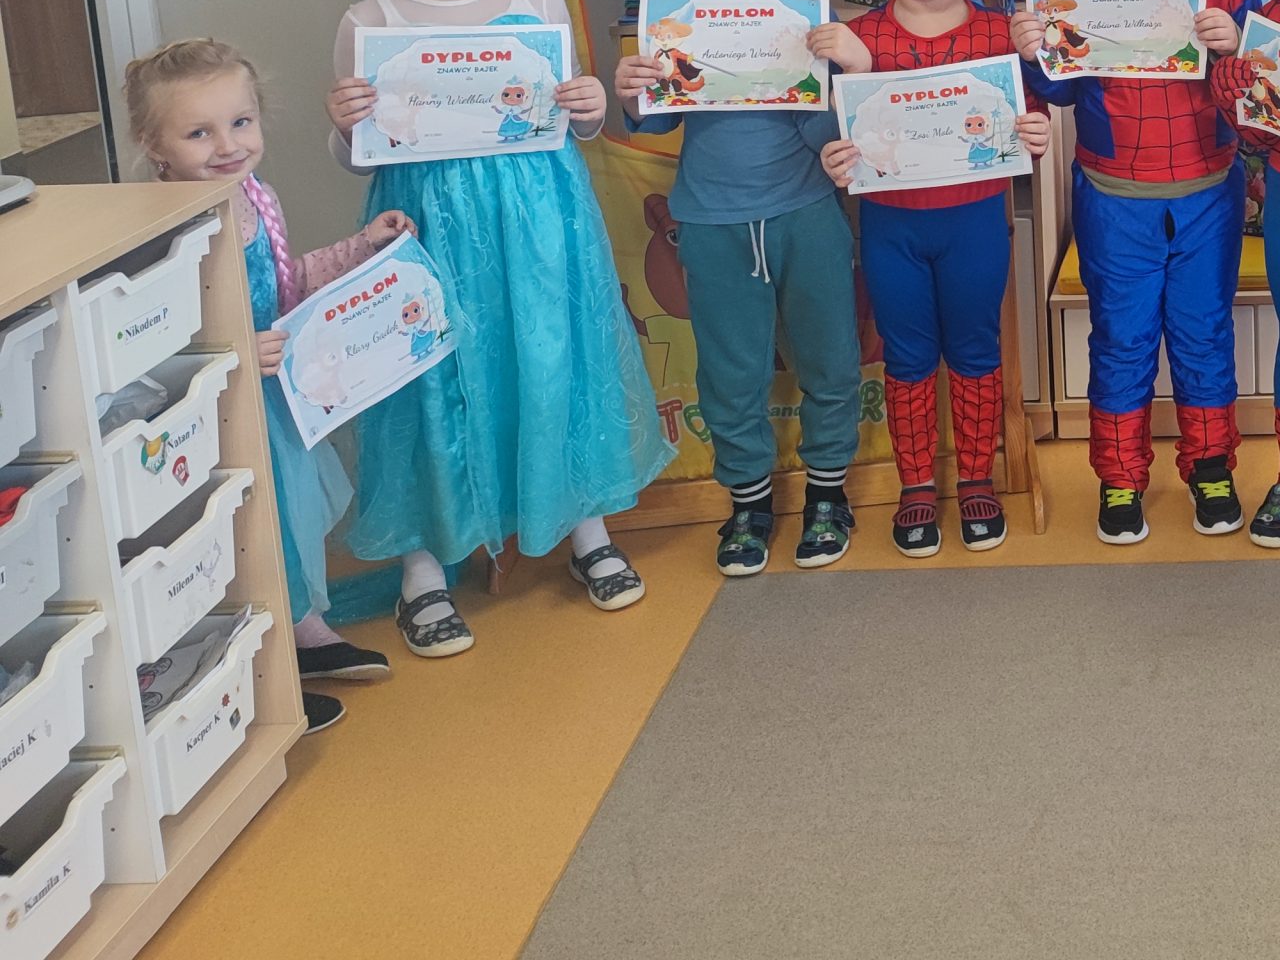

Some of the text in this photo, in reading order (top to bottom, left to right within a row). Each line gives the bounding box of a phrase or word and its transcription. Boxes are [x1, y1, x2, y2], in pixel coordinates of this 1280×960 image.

[695, 8, 775, 19] DYPLOM
[421, 50, 512, 64] DYPLOM
[889, 85, 969, 104] DYPLOM
[324, 273, 399, 322] DYPLOM
[125, 312, 161, 339] Nikodem
[167, 572, 195, 600] Milena
[0, 729, 38, 770] aciej K
[186, 721, 213, 753] Kacper
[24, 873, 60, 914] Kamila
